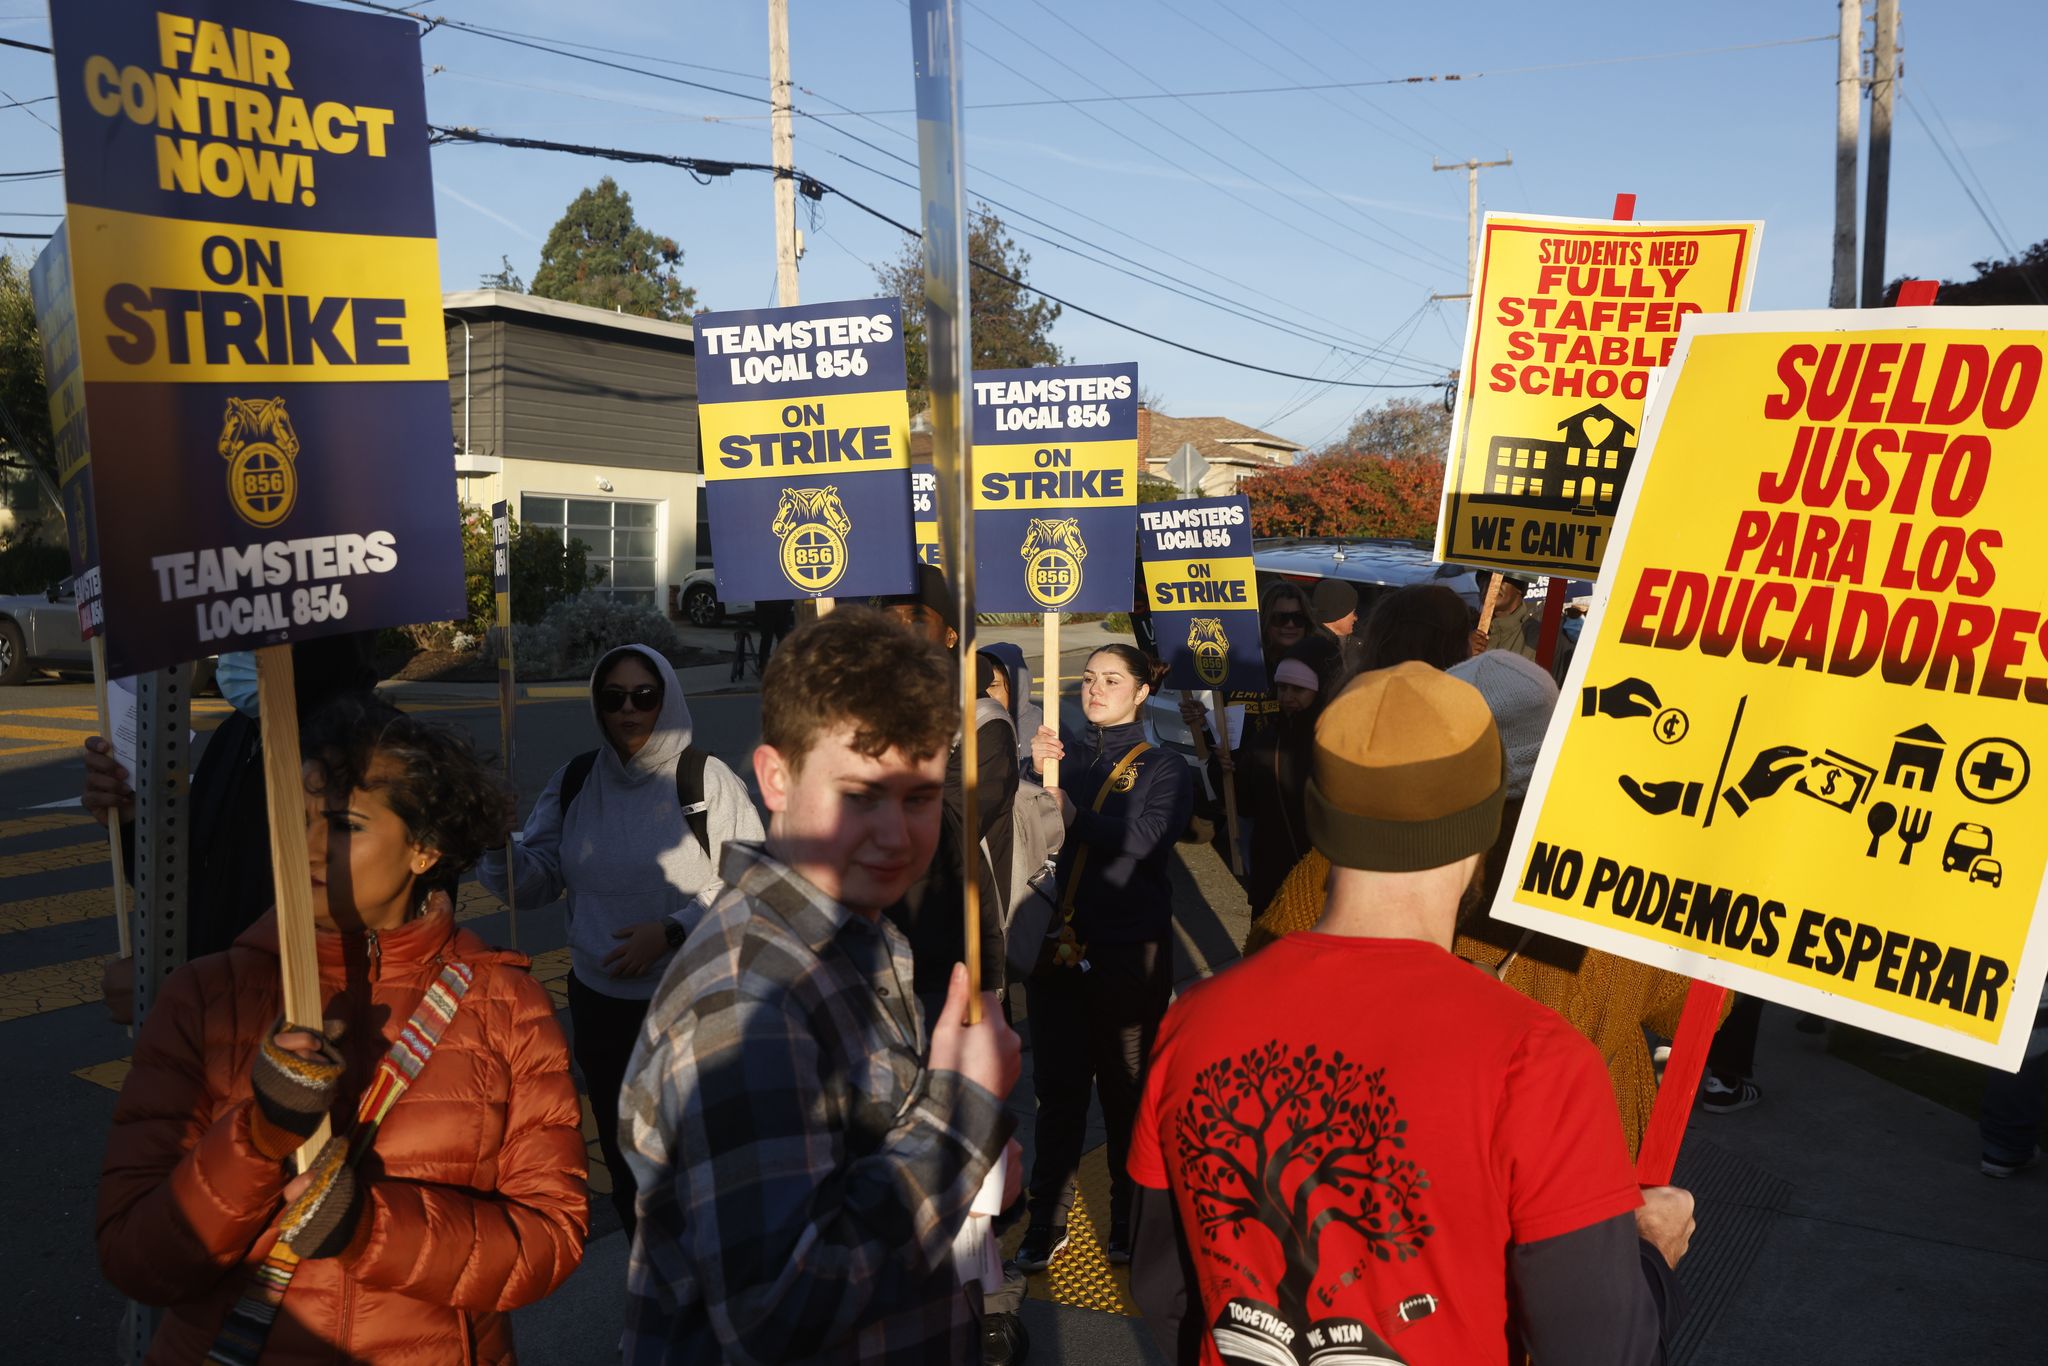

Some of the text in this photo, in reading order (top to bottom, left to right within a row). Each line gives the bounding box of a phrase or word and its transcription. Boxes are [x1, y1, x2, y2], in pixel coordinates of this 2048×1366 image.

[157, 11, 293, 90] FAIR
[84, 54, 395, 158] CONTRACT
[155, 135, 316, 207] NOW!
[201, 235, 283, 288] ON
[1538, 238, 1699, 266] STUDENTS NEED
[1537, 267, 1690, 298] FULLY
[105, 282, 410, 365] STRIKE
[702, 314, 894, 355] TEAMSTERS
[730, 348, 868, 385] LOCAL 856
[973, 375, 1132, 405] TEAMSTERS
[1764, 343, 2043, 430] SUELDO
[781, 403, 825, 428] ON
[995, 404, 1110, 431] LOCAL 856
[719, 425, 892, 469] STRIKE
[1034, 449, 1071, 468] ON
[243, 472, 283, 496] 856
[981, 469, 1124, 501] STRIKE
[1758, 426, 1992, 518] JUSTO
[1140, 505, 1245, 531] TEAMSTERS
[1156, 529, 1231, 551] LOCAL 856
[1472, 515, 1602, 562] WE CAN'T
[1725, 510, 2004, 598] PARA LOS
[152, 530, 398, 602] TEAMSTERS
[796, 548, 832, 565] 856
[1187, 563, 1211, 579] ON
[1037, 570, 1069, 584] 856
[1155, 580, 1247, 605] STRIKE
[196, 583, 349, 641] LOCAL 856
[1202, 657, 1222, 669] 856
[1522, 841, 2011, 1022] NO PODEMOS ESPERAR
[1228, 1302, 1296, 1346] TOGETHER
[1328, 1324, 1363, 1344] WIN
